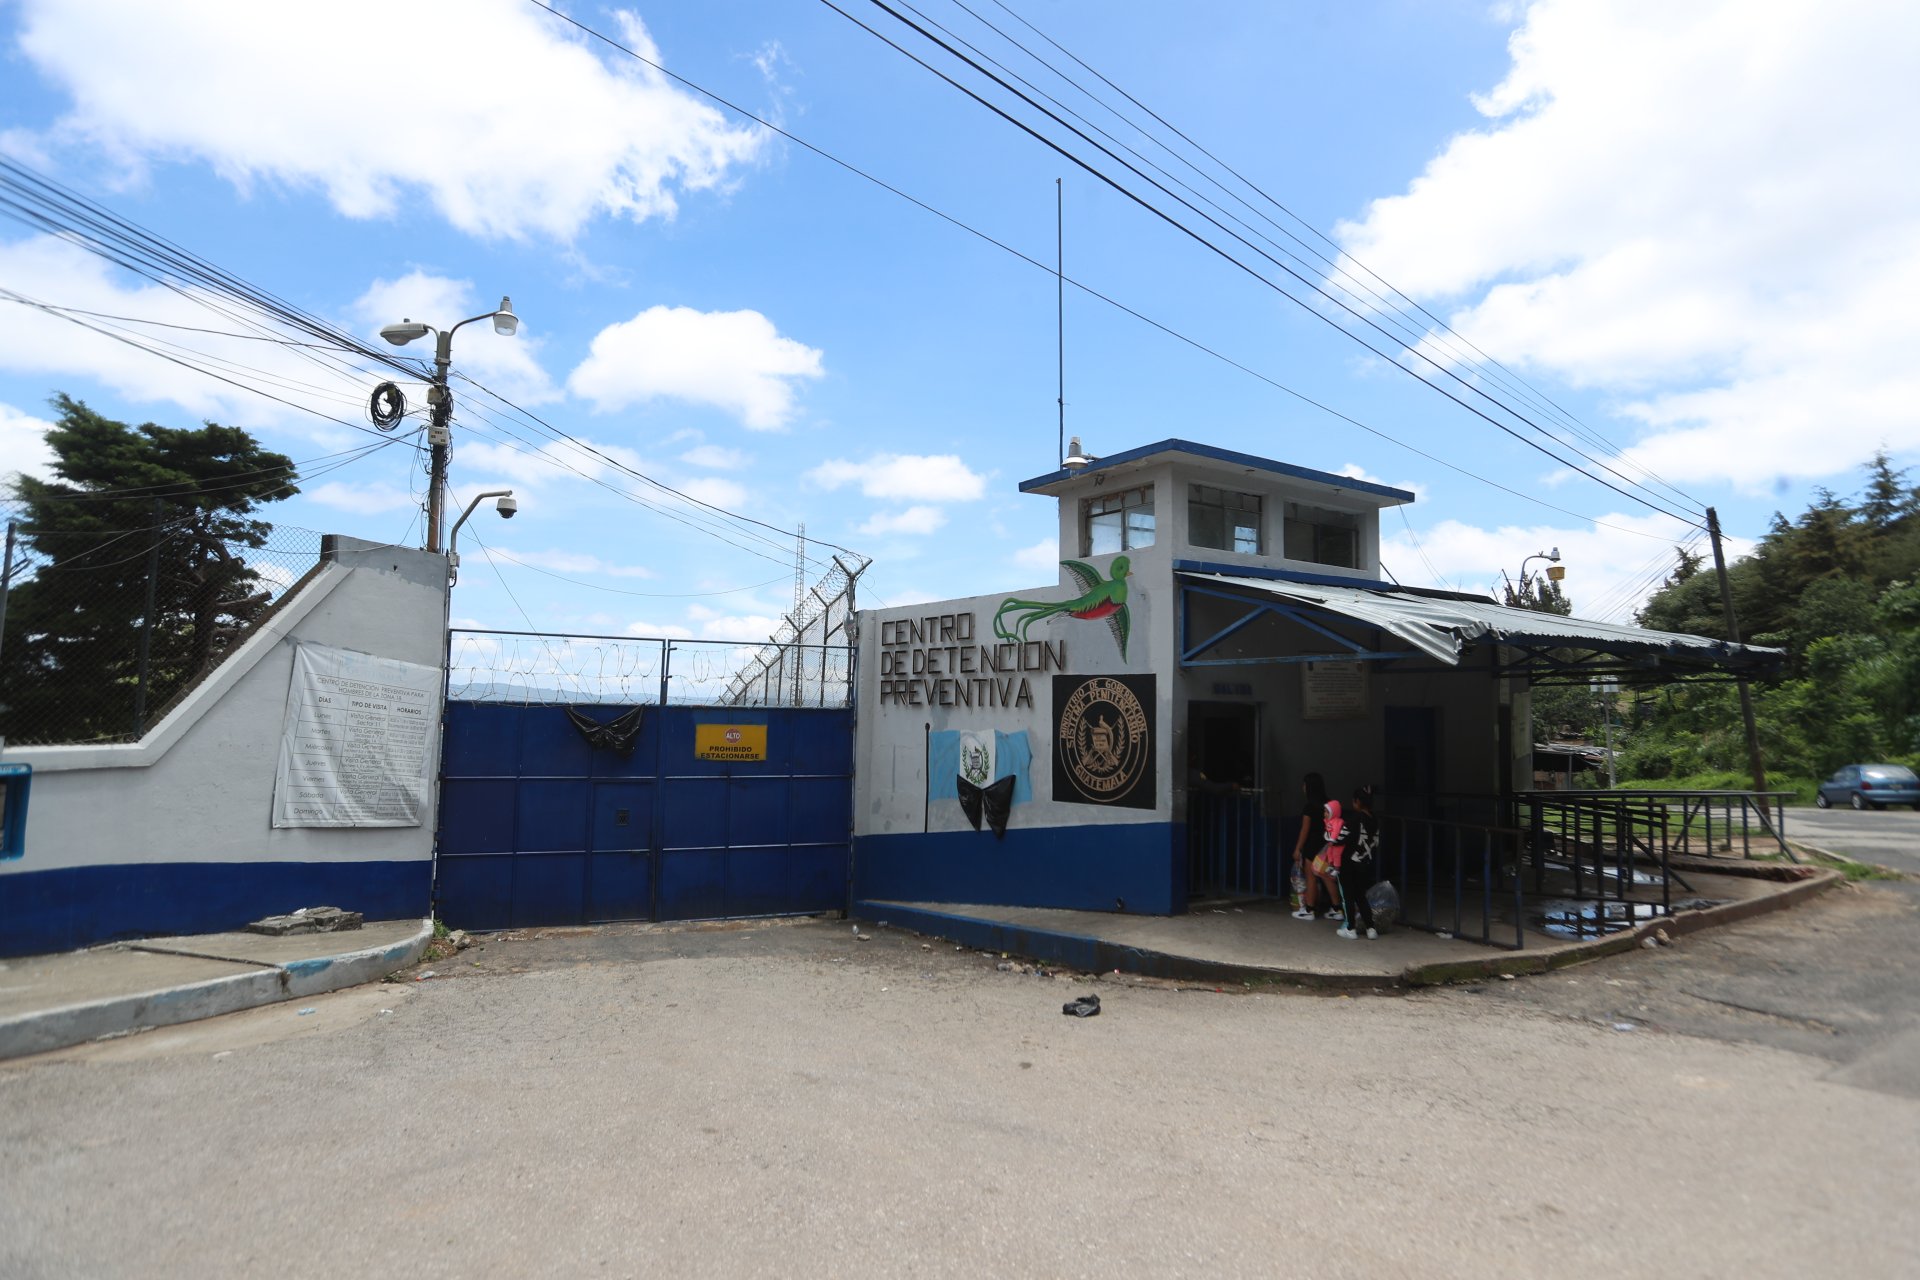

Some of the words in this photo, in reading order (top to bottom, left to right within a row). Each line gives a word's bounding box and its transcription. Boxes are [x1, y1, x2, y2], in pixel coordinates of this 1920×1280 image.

[880, 611, 973, 647] CENTRO
[879, 649, 908, 677] DE
[912, 638, 1065, 676] DETENCION
[317, 677, 339, 686] CENTRO
[381, 686, 411, 697] PREVENTIVA
[411, 691, 425, 699] PARA
[338, 687, 364, 696] HOMBRES
[879, 677, 1033, 709] PREVENTIVA
[318, 695, 332, 704] DÍAS
[351, 700, 364, 708] TIPO
[372, 702, 387, 711] VISITA
[397, 706, 422, 716] HORARIOS
[1060, 688, 1085, 740] MINISTERIO
[1089, 680, 1099, 690] DE
[313, 711, 332, 720] Lunes
[364, 713, 386, 722] General
[1067, 702, 1087, 750] SISTEMA
[1090, 688, 1140, 744] PENITENCIARIO
[363, 728, 385, 736] General
[700, 752, 760, 760] ESTACIONARSE
[709, 745, 752, 753] PROHIBIDO
[305, 759, 326, 767] Jueves
[1075, 764, 1128, 791] GUATEMALA
[293, 807, 324, 817] Domingo
